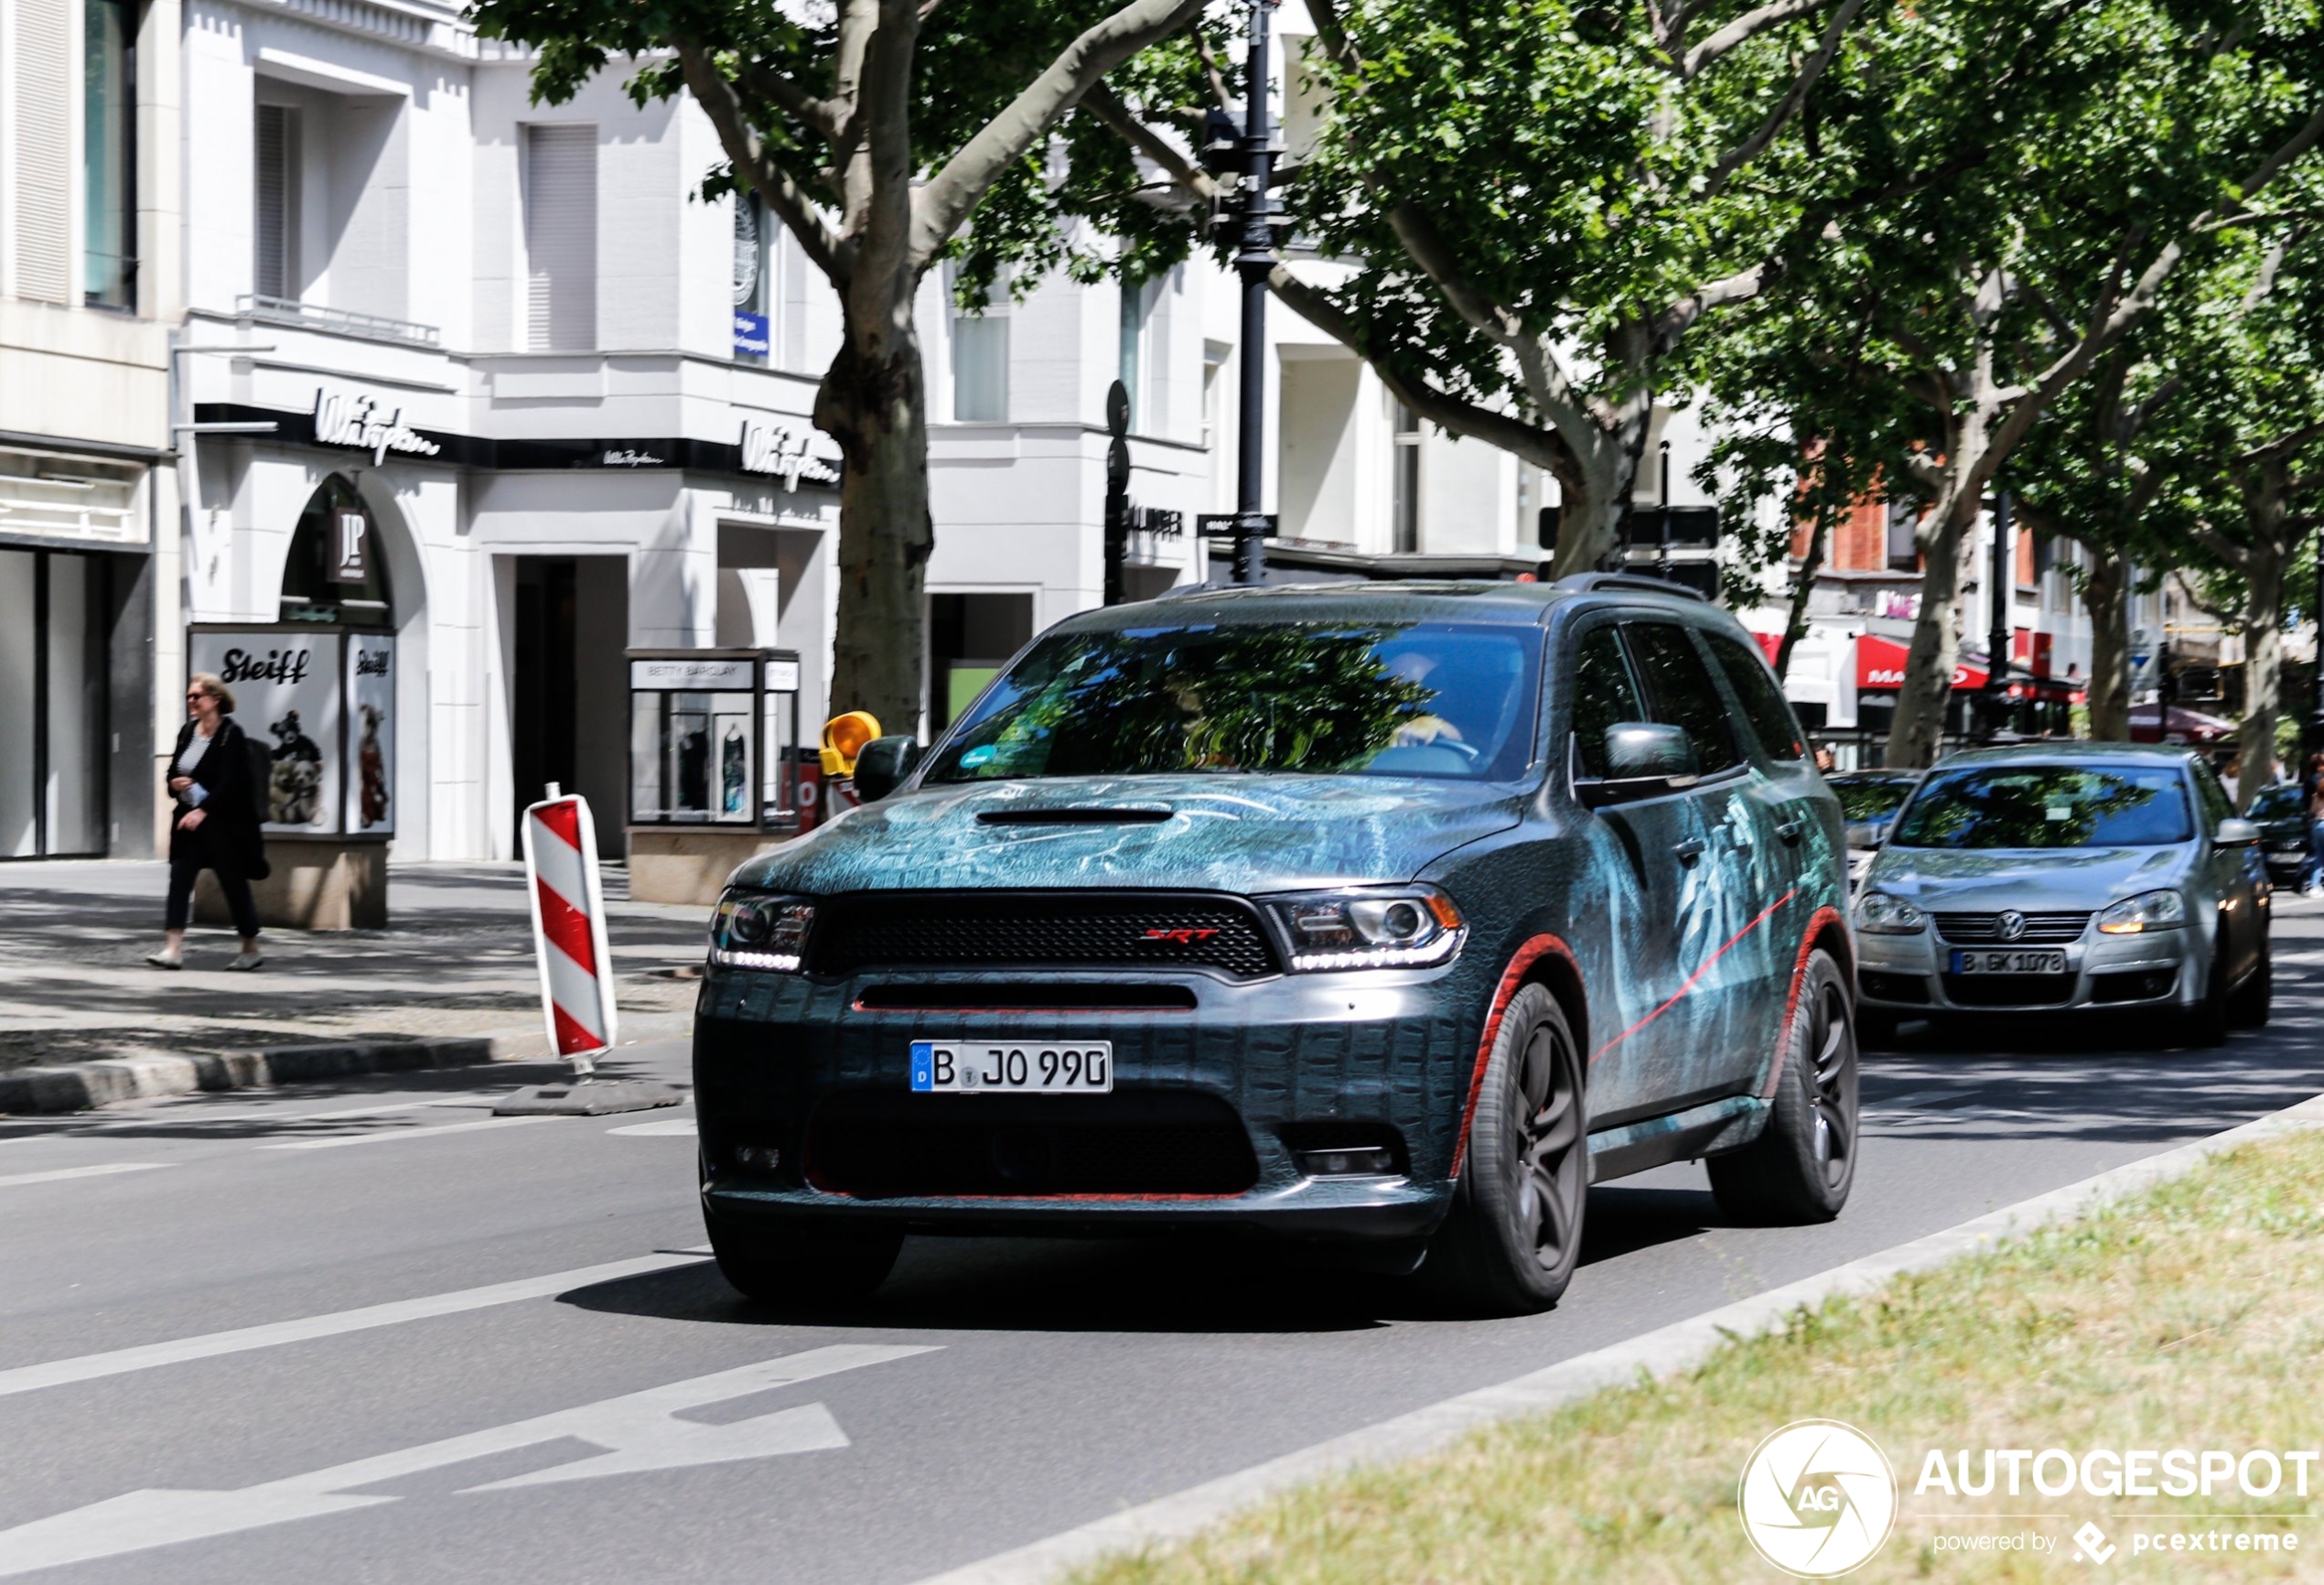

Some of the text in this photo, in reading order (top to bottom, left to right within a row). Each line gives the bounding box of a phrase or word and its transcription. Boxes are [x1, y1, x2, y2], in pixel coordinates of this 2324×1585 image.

[221, 648, 310, 685] Steiff
[648, 665, 737, 676] BETTY BARCLAY
[1140, 929, 1220, 943] SRT
[1963, 954, 1975, 972] B
[933, 1050, 956, 1085] B
[982, 1049, 1028, 1085] JO
[1038, 1050, 1106, 1085] 990
